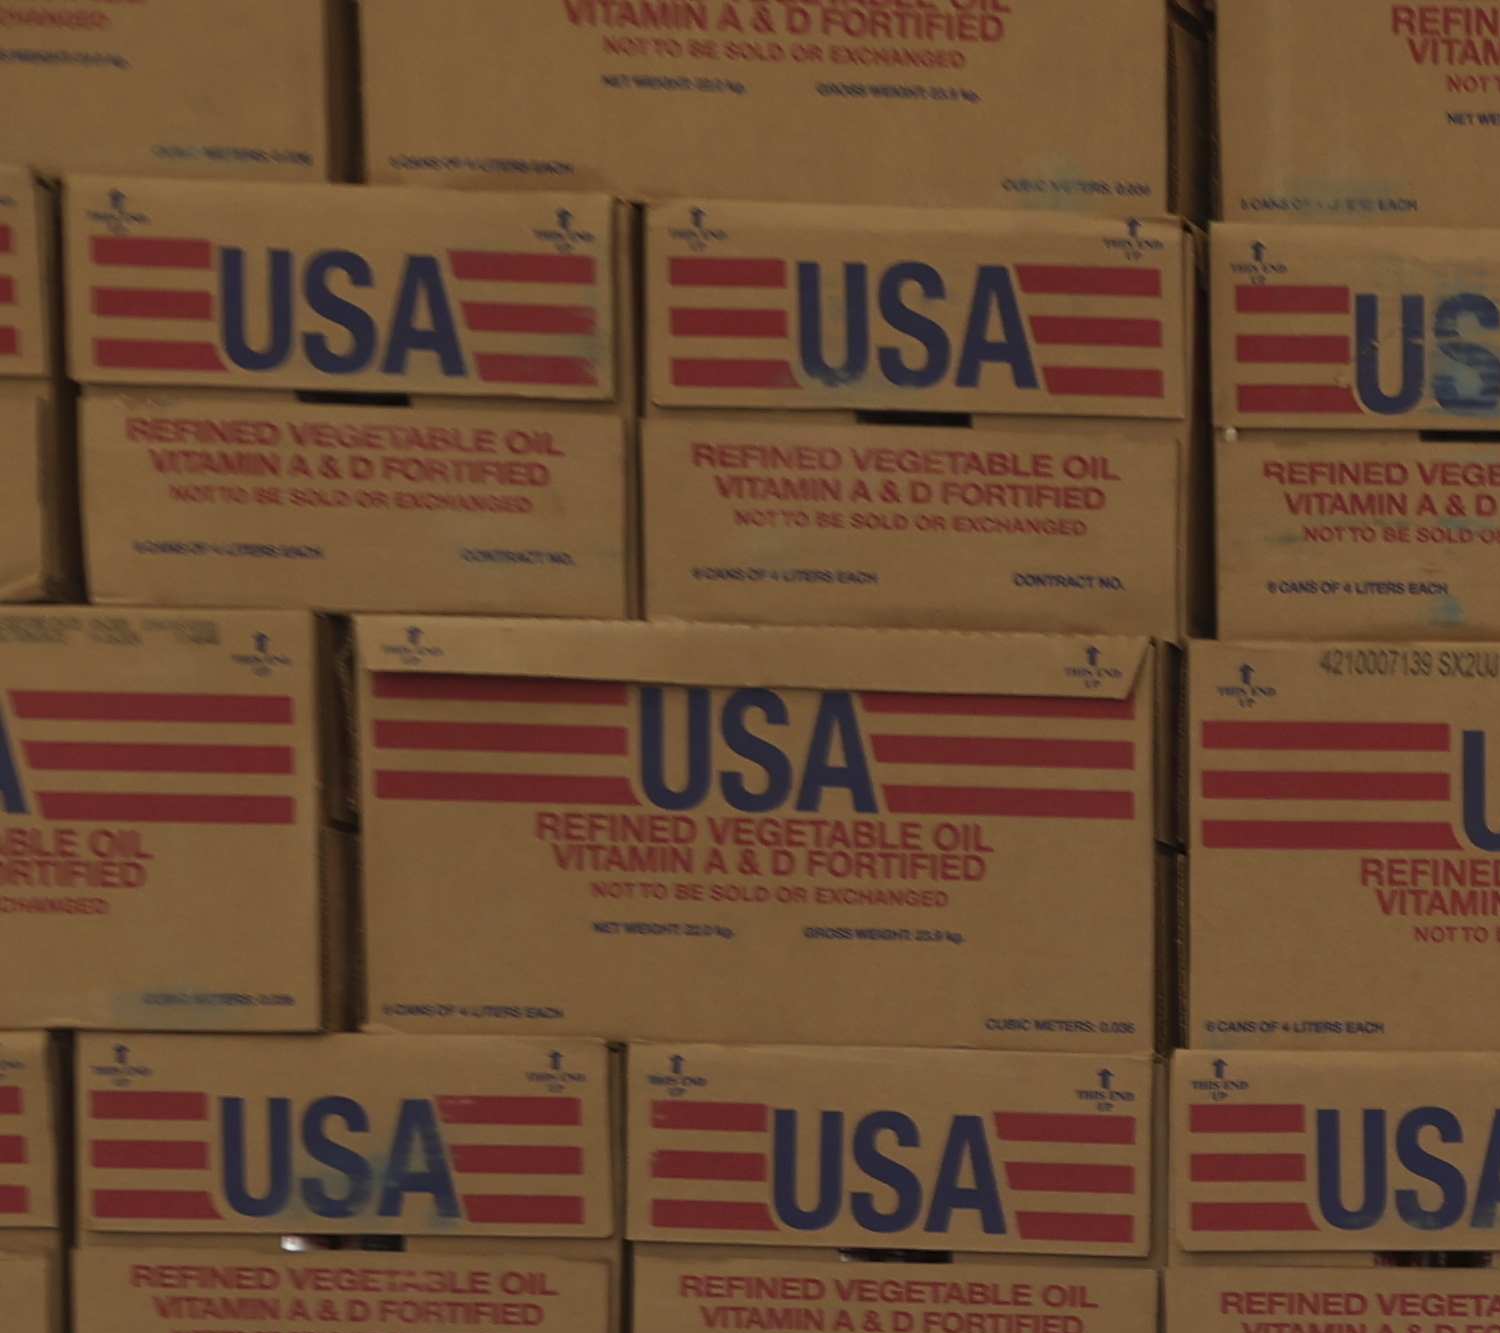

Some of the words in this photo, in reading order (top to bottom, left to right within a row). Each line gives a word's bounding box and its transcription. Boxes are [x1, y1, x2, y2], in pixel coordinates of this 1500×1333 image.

[222, 248, 466, 376] USA
[641, 687, 877, 813] USA
[774, 1109, 1006, 1234] USA
